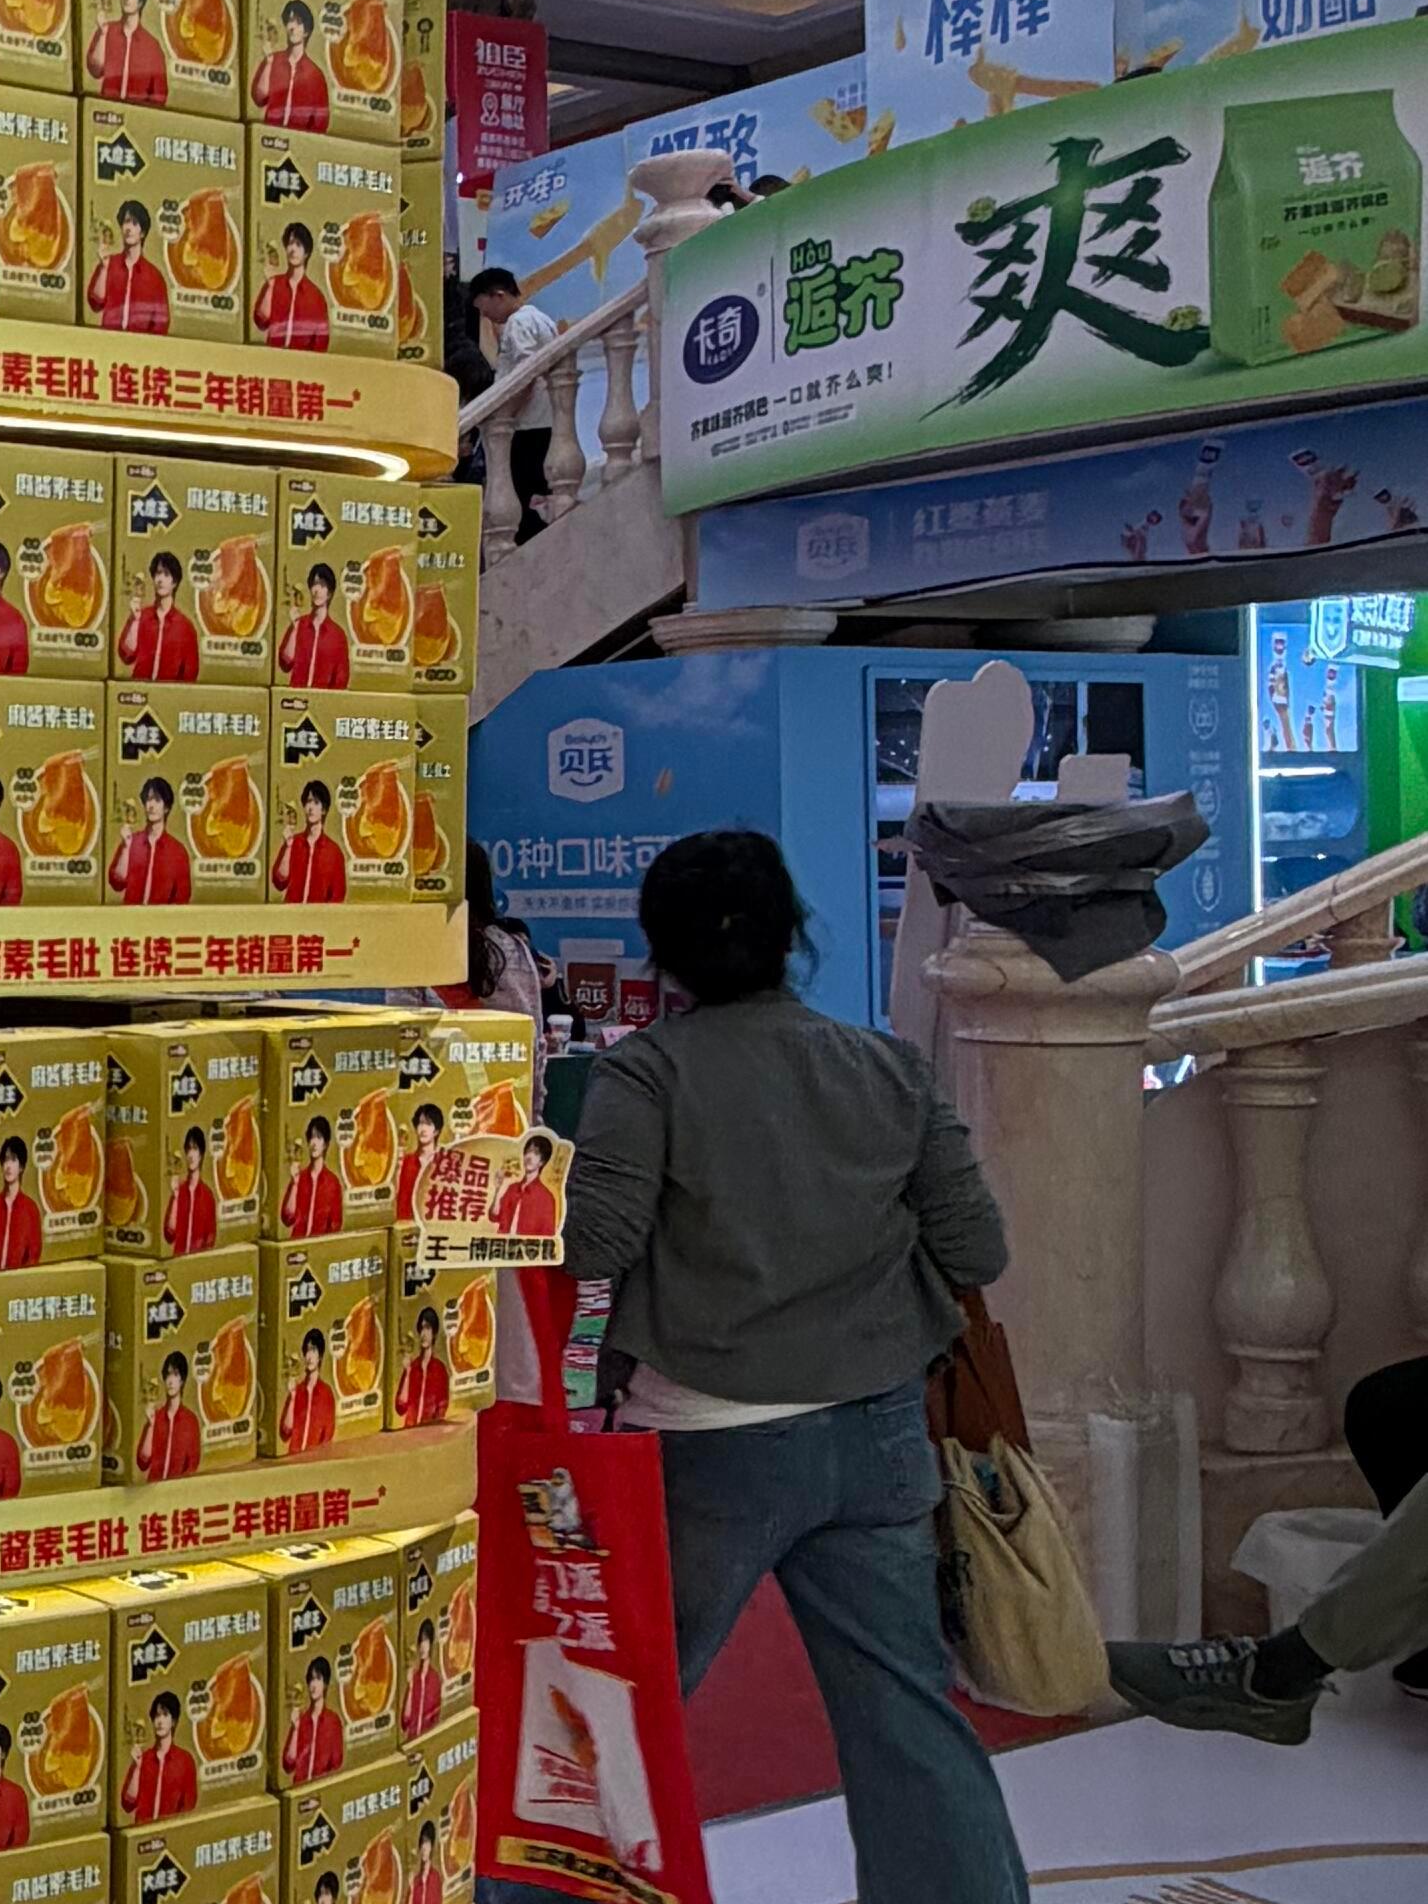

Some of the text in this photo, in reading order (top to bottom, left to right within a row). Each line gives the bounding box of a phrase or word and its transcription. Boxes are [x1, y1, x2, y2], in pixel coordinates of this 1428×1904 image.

[921, 134, 1213, 422] 爽
[560, 746, 614, 775] 贝氏
[431, 1150, 490, 1184] 爆品
[425, 1185, 488, 1222] 推荐
